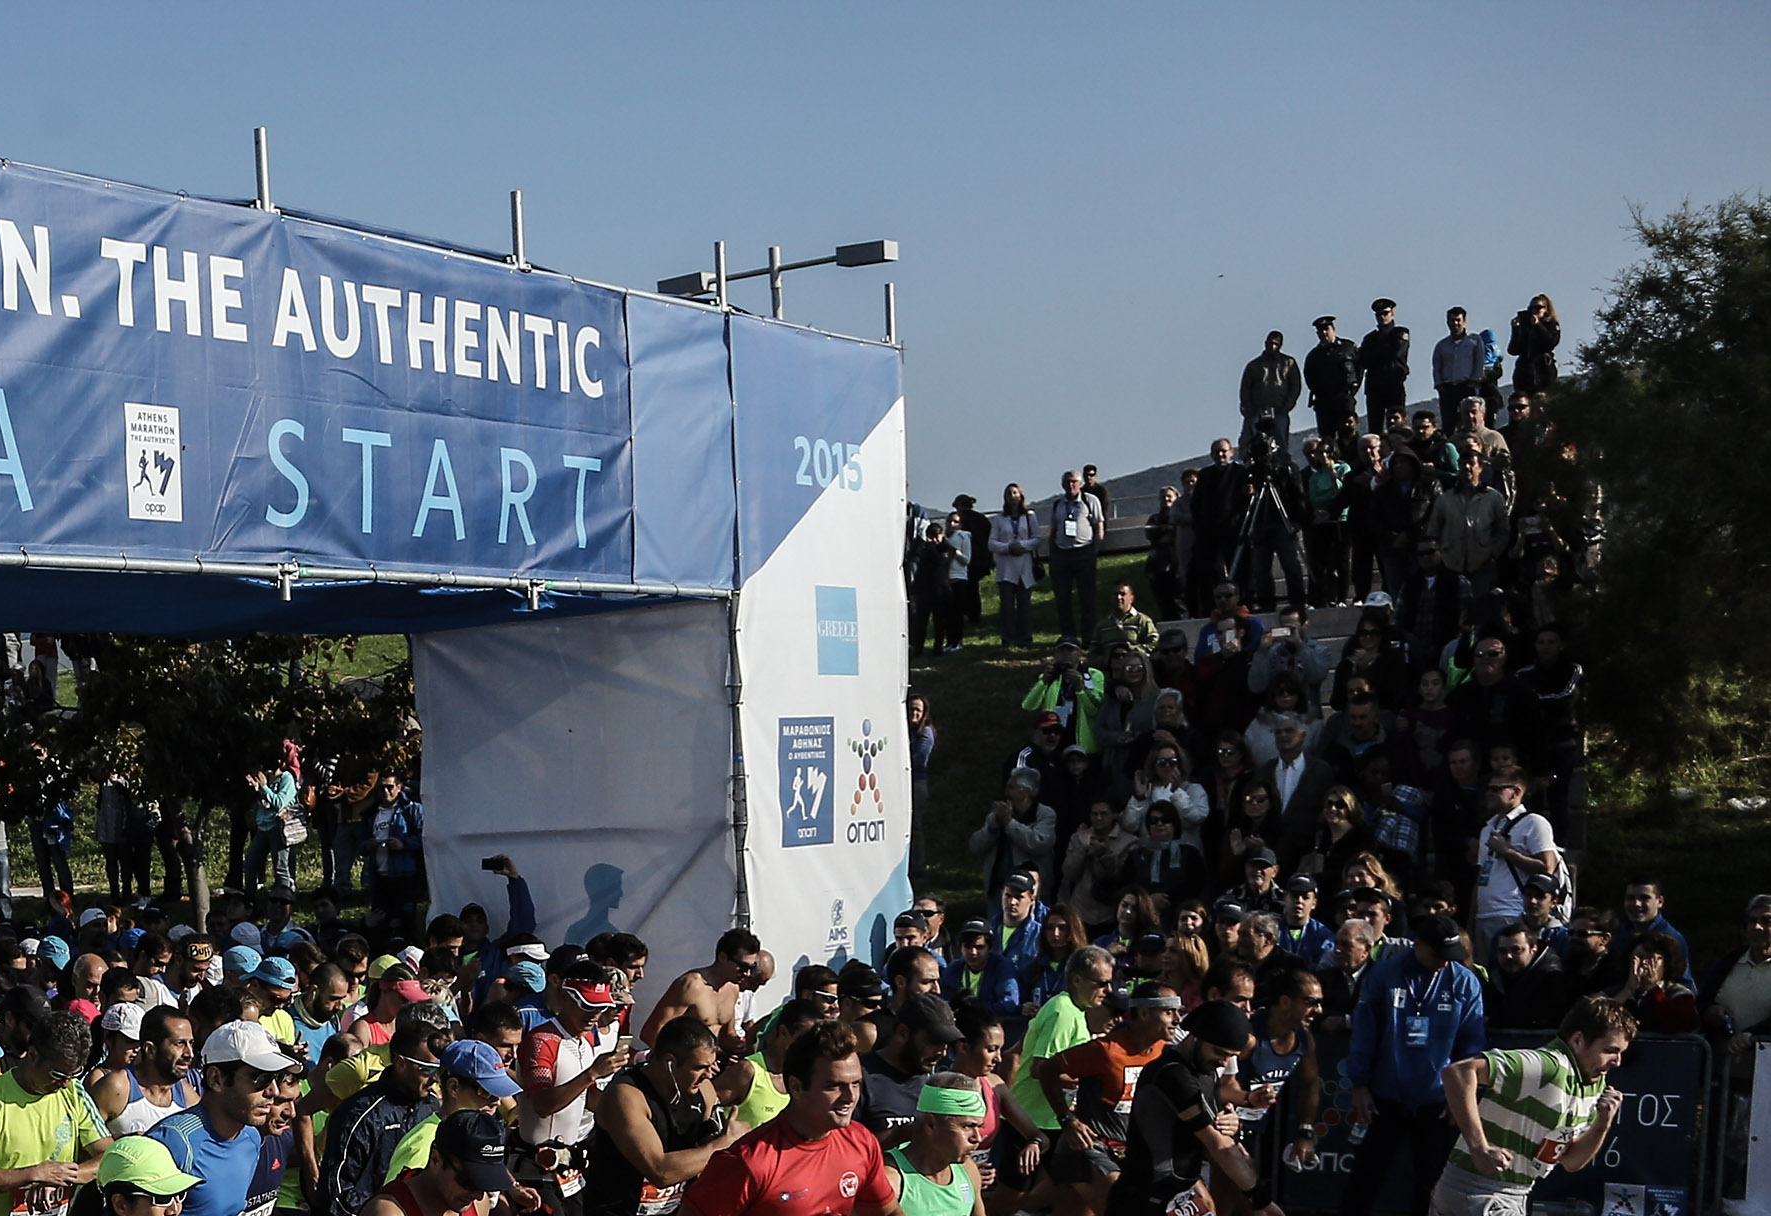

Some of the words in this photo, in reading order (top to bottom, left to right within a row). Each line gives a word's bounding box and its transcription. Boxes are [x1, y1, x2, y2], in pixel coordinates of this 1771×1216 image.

[100, 236, 248, 343] THE
[272, 267, 604, 399] AUTHENTIC
[137, 411, 168, 423] ATHENS
[130, 422, 175, 435] MARATHON
[130, 434, 142, 442] THE
[143, 436, 176, 445] AUTHENTIC
[794, 436, 863, 491] 2015
[265, 418, 603, 549] START
[145, 503, 166, 516] opap
[818, 620, 859, 637] GREECE
[792, 737, 823, 749] ΑΘΗΝΑΣ
[828, 926, 848, 941] AIMS
